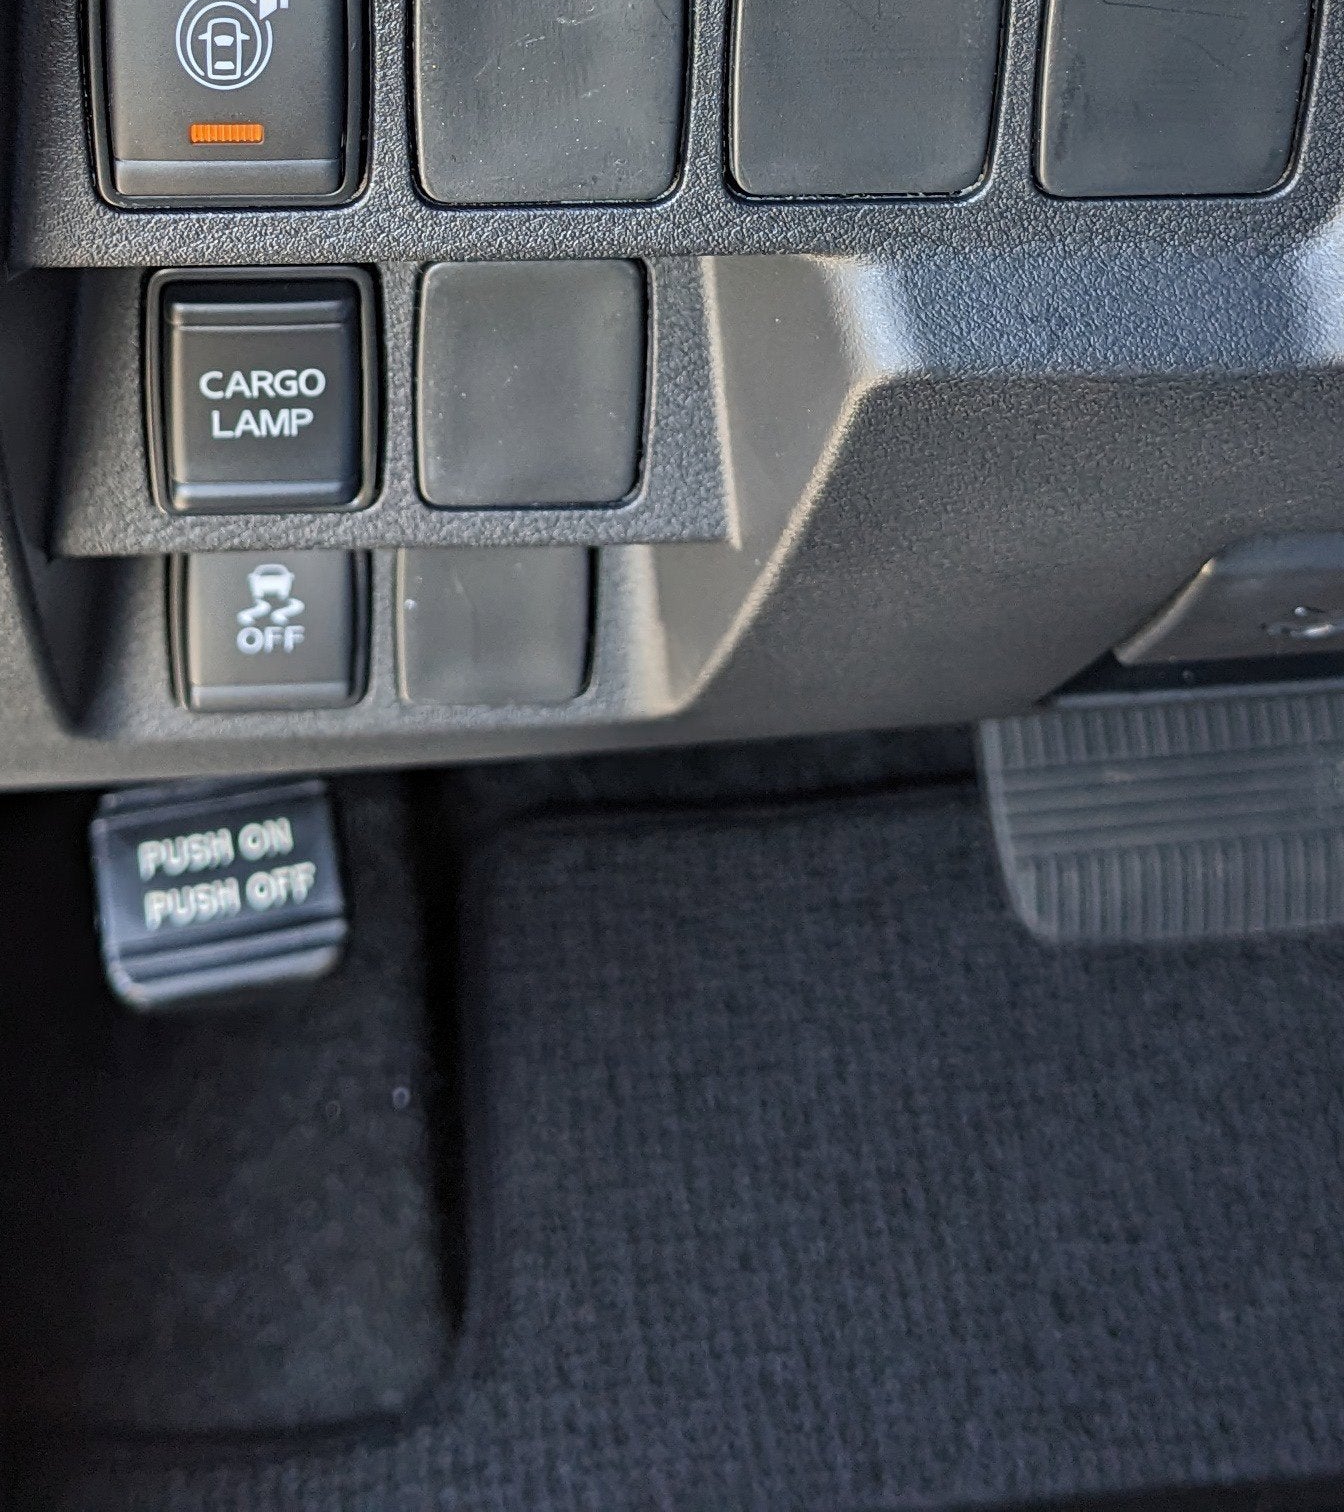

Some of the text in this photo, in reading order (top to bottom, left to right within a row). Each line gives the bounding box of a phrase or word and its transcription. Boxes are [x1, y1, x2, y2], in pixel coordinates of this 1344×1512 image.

[199, 369, 326, 399] CARGO
[211, 408, 314, 438] LAMP
[236, 625, 306, 653] OFF
[138, 818, 293, 880] PUSH ON
[145, 863, 317, 929] PUSH OFF
